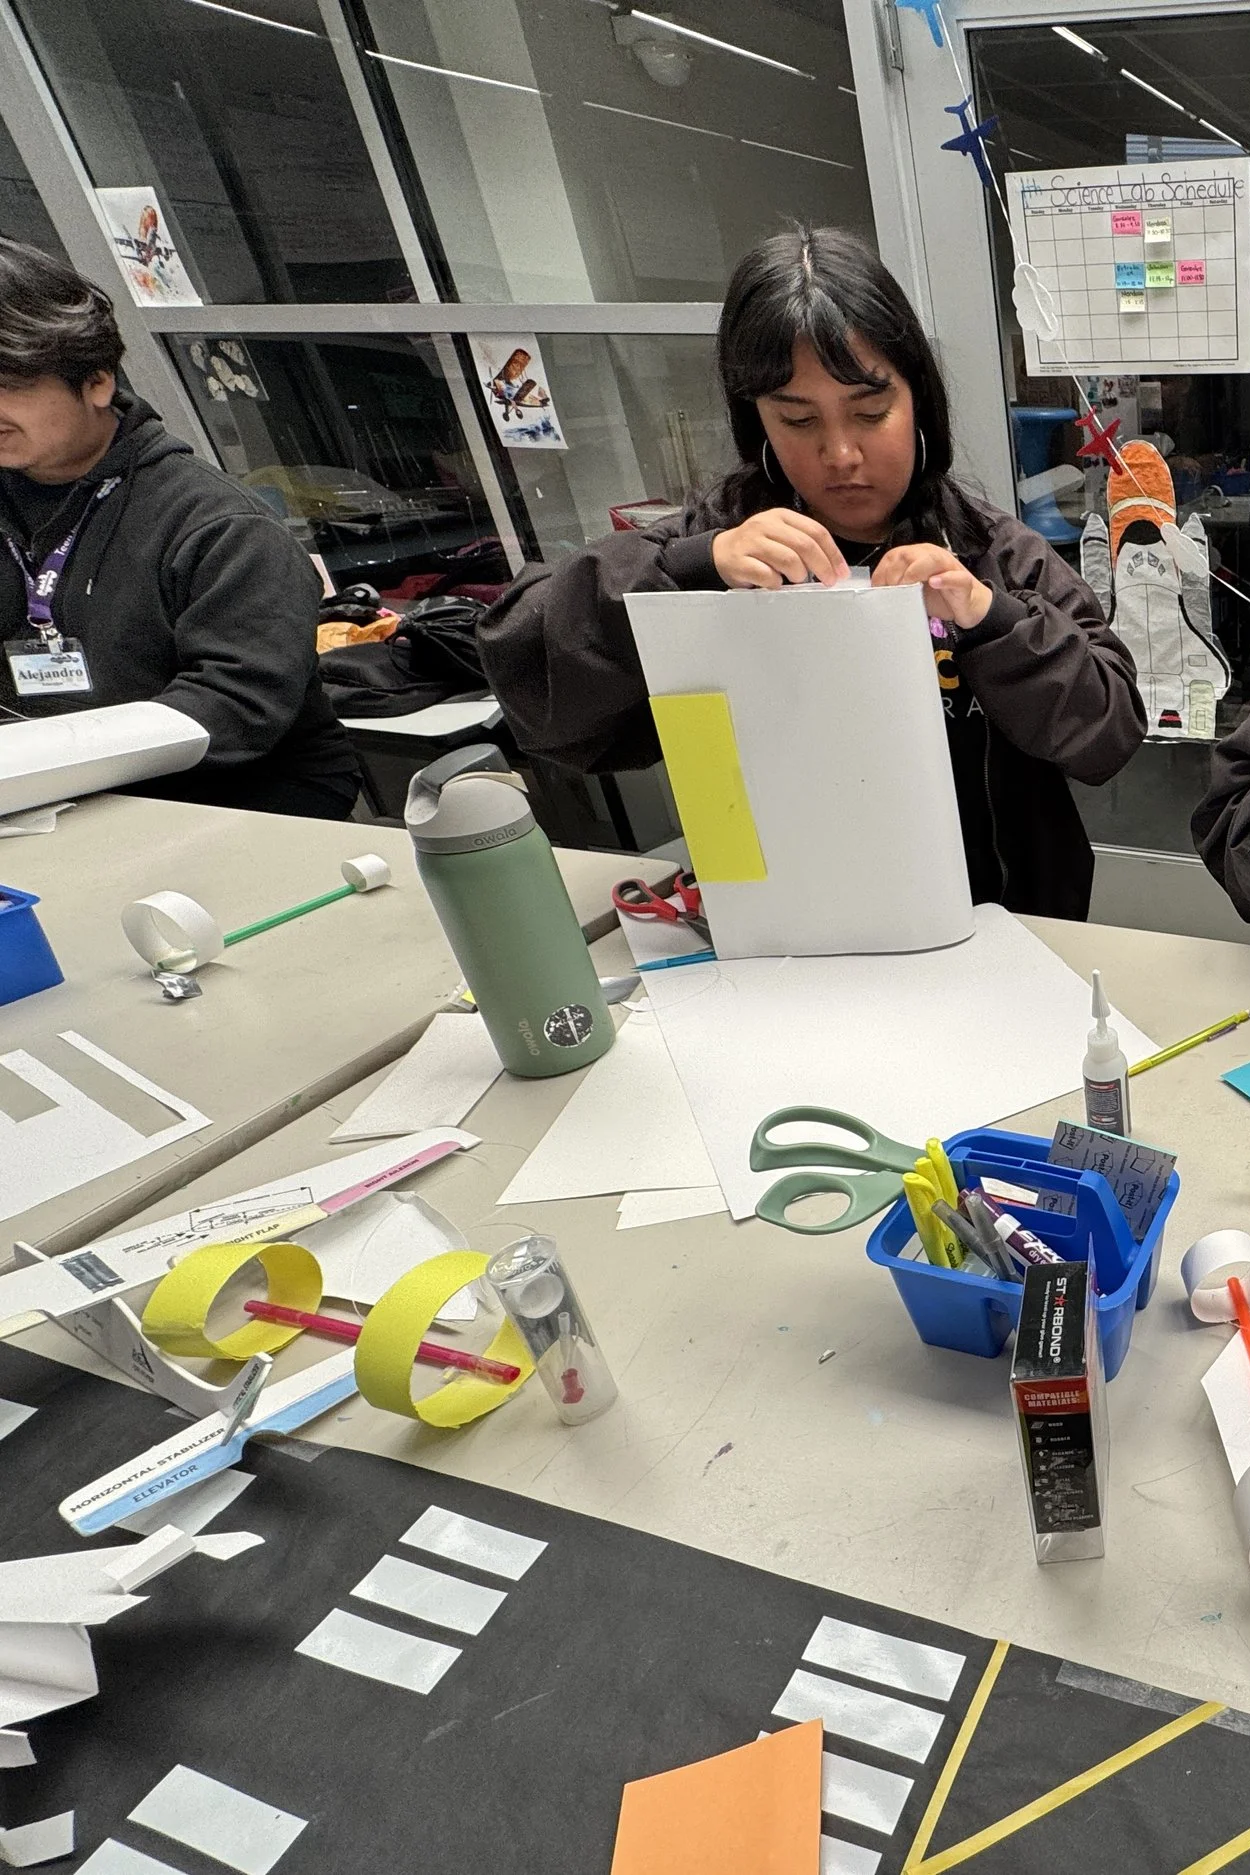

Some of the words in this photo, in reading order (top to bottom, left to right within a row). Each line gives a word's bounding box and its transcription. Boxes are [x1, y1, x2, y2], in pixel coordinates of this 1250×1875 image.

[1051, 175, 1113, 207] Science
[1117, 170, 1155, 203] Lab
[1161, 170, 1245, 200] Schedule
[18, 667, 84, 682] Alejandro
[474, 827, 517, 847] owala
[519, 1018, 541, 1057] owala
[255, 1224, 280, 1236] FLAP
[1024, 1390, 1080, 1401] COMPATIBLE
[69, 1466, 156, 1513] HORIZONTAL
[158, 1427, 226, 1466] STABILIZER
[132, 1464, 199, 1503] ELEVATOR
